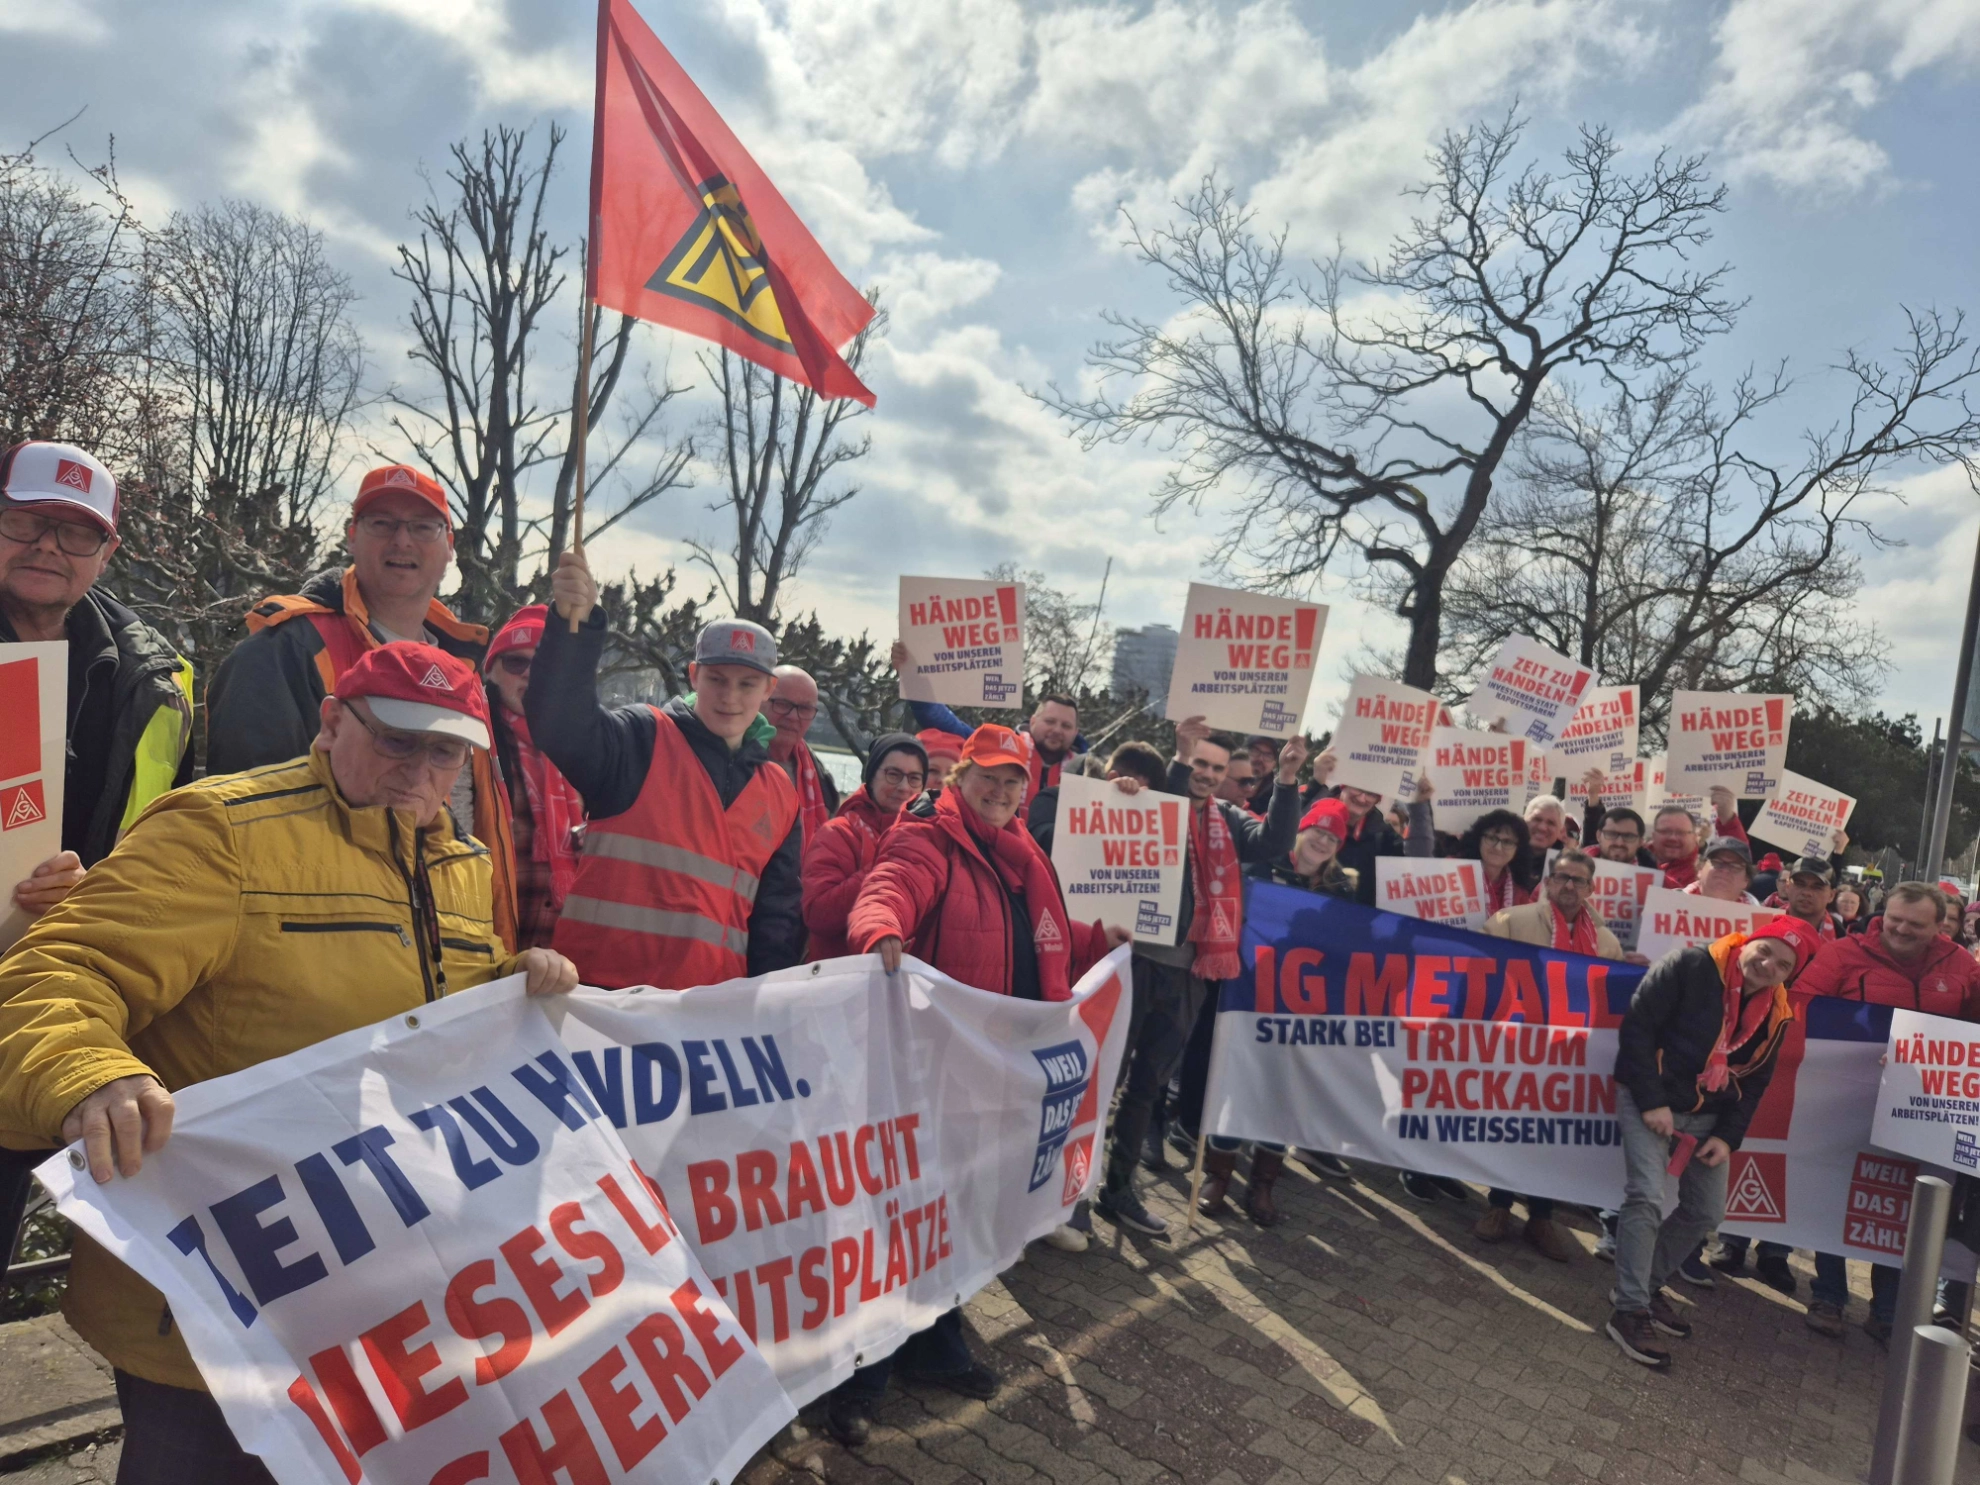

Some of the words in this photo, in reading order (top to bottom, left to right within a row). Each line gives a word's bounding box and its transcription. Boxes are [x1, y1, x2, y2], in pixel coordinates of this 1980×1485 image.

[910, 595, 997, 626] HÄNDE
[1194, 608, 1291, 640] HÄNDE
[917, 658, 1003, 673] ARBEITSPLÄTZEN!
[934, 652, 954, 661] VON
[957, 647, 1001, 659] UNSEREN
[1213, 671, 1236, 680] VON
[1240, 672, 1288, 681] UNSEREN
[1513, 657, 1549, 679] ZEIT
[1550, 670, 1573, 687] ZU
[1191, 682, 1287, 694] ARBEITSPLÄTZEN!
[1601, 701, 1620, 716] ZU
[1681, 706, 1764, 732] HÄNDE
[1561, 717, 1622, 739] ANDELN
[1685, 760, 1765, 772] ARBEITSPLÄTZEN!
[1702, 754, 1721, 762] VON
[1724, 750, 1765, 760] UNSEREN
[1787, 790, 1816, 806] ZEIT
[1819, 799, 1836, 812] ZU
[1069, 801, 1159, 835] HÄNDE
[1090, 869, 1111, 879] VON
[1115, 869, 1160, 879] UNSEREN
[1069, 881, 1160, 894] ARBEITSPLÄTZEN!
[1255, 945, 1327, 1016] IG
[1344, 952, 1626, 1030] METALL
[1255, 1017, 1347, 1046] STARK
[1354, 1020, 1395, 1047] BEI
[1402, 1021, 1588, 1067] TRIVIUM
[1041, 1051, 1083, 1085] WEIL
[1402, 1068, 1617, 1114] PACKAGIN
[1909, 1096, 1929, 1108] VON
[1932, 1098, 1979, 1112] UNSEREN
[1043, 1100, 1071, 1135] DAS
[1891, 1107, 1979, 1126] ARBEITSPLÄTZEN!
[408, 1085, 540, 1191] ZU
[1399, 1115, 1428, 1140] IN
[1435, 1115, 1624, 1147] WEISSENTHU
[1958, 1133, 1973, 1143] WEIL
[1956, 1144, 1969, 1153] DAS
[687, 1113, 921, 1245] BRAUCHT
[1860, 1160, 1908, 1186] WEIL
[1853, 1191, 1896, 1215] DAS
